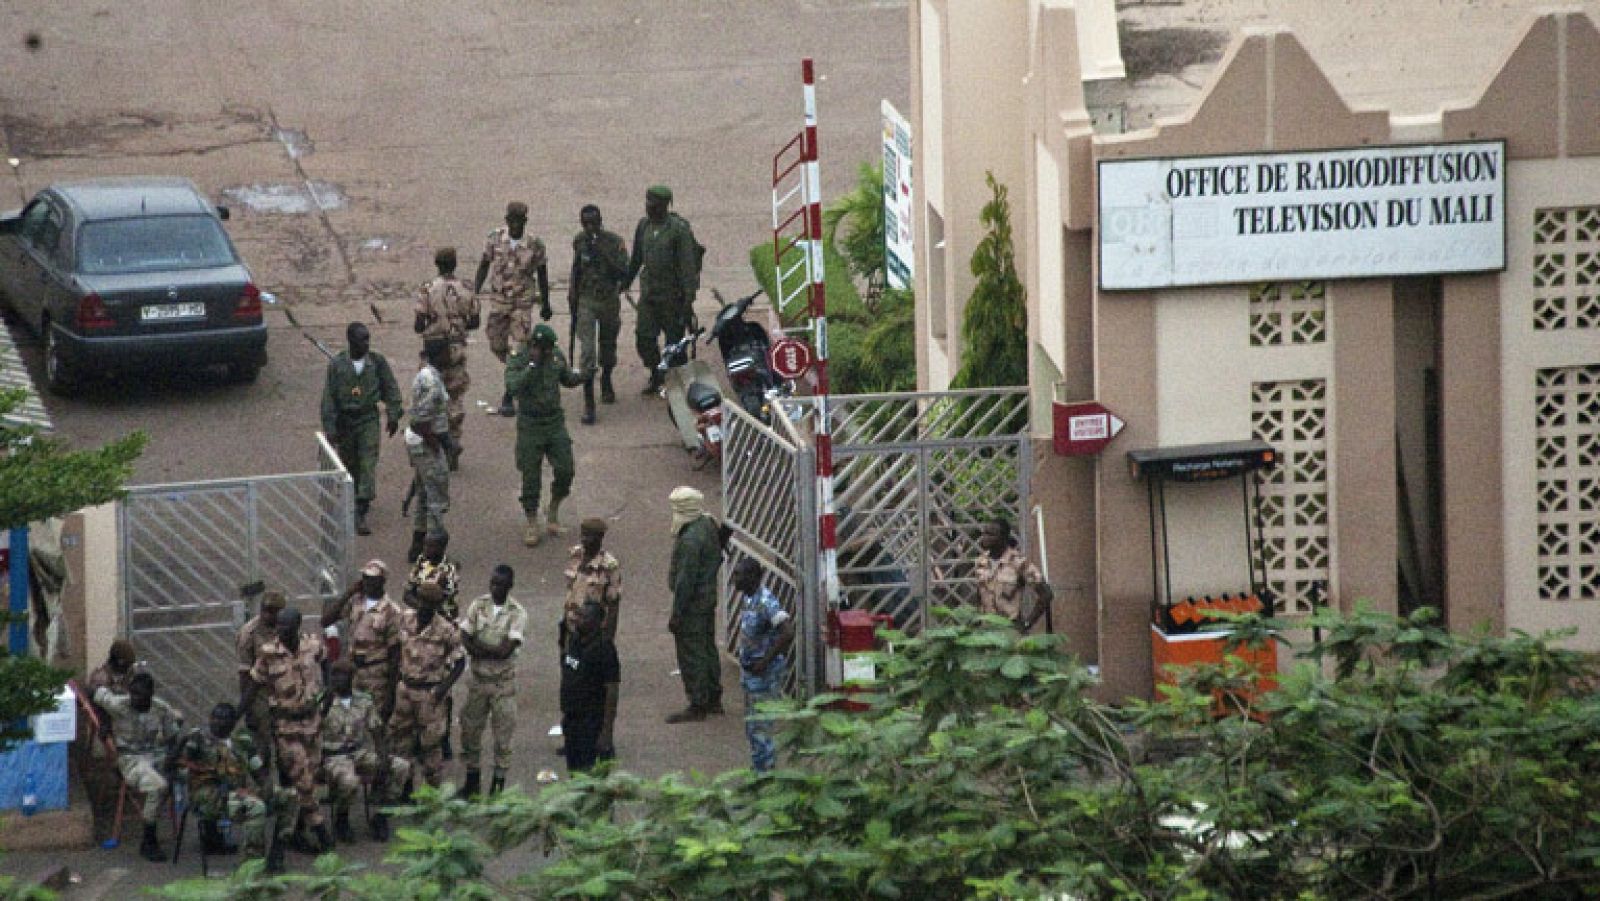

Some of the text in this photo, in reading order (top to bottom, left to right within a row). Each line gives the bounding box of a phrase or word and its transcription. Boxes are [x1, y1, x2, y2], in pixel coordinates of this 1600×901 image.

[1166, 151, 1498, 199] OFFICE DE RADIODIFFUSION
[1233, 193, 1494, 236] TELEVISION DU MALI
